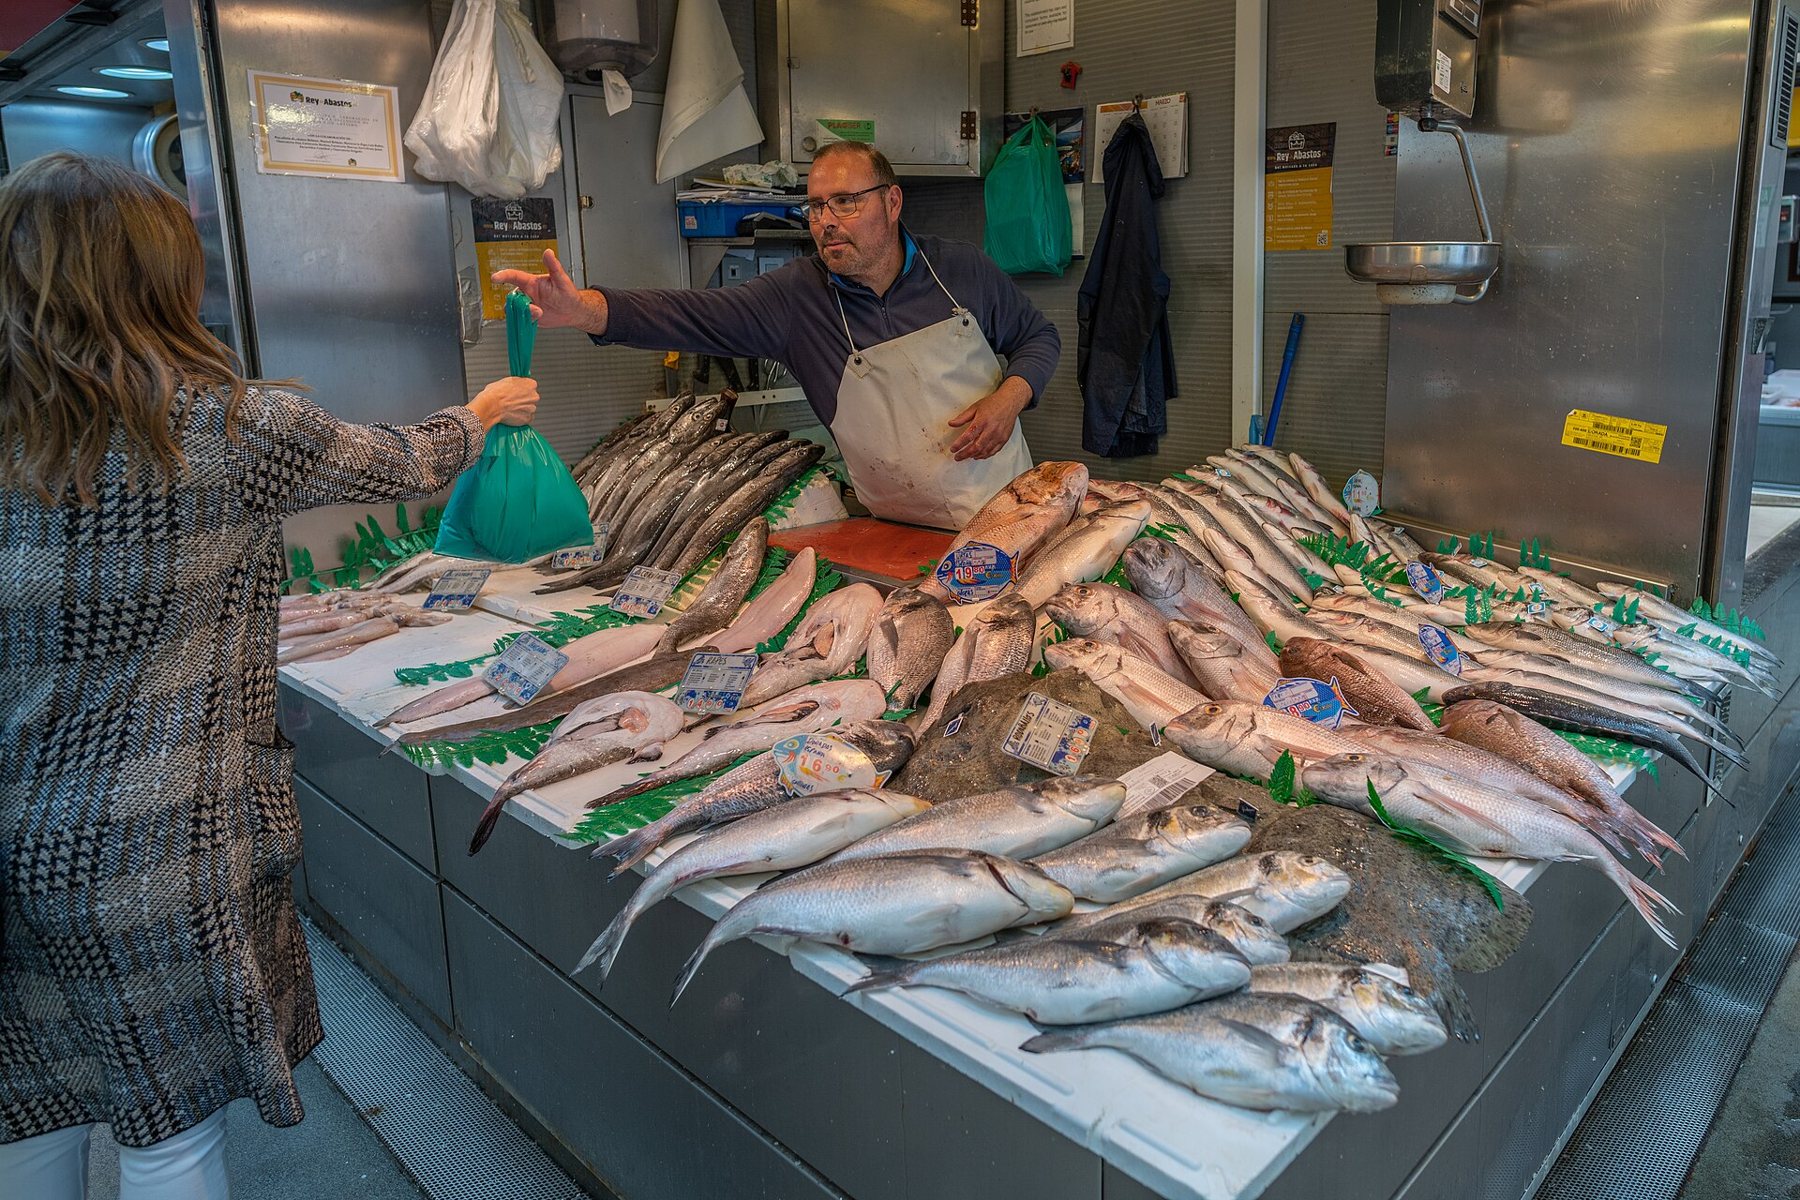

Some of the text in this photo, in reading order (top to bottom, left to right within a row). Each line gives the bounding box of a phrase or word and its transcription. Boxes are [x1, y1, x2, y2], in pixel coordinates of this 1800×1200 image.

[305, 96, 353, 108] Rey Abastos
[1276, 151, 1290, 162] Rey
[1293, 149, 1321, 160] Abastos
[494, 220, 508, 231] Rey
[512, 220, 542, 231] Abastos
[955, 566, 972, 580] 19
